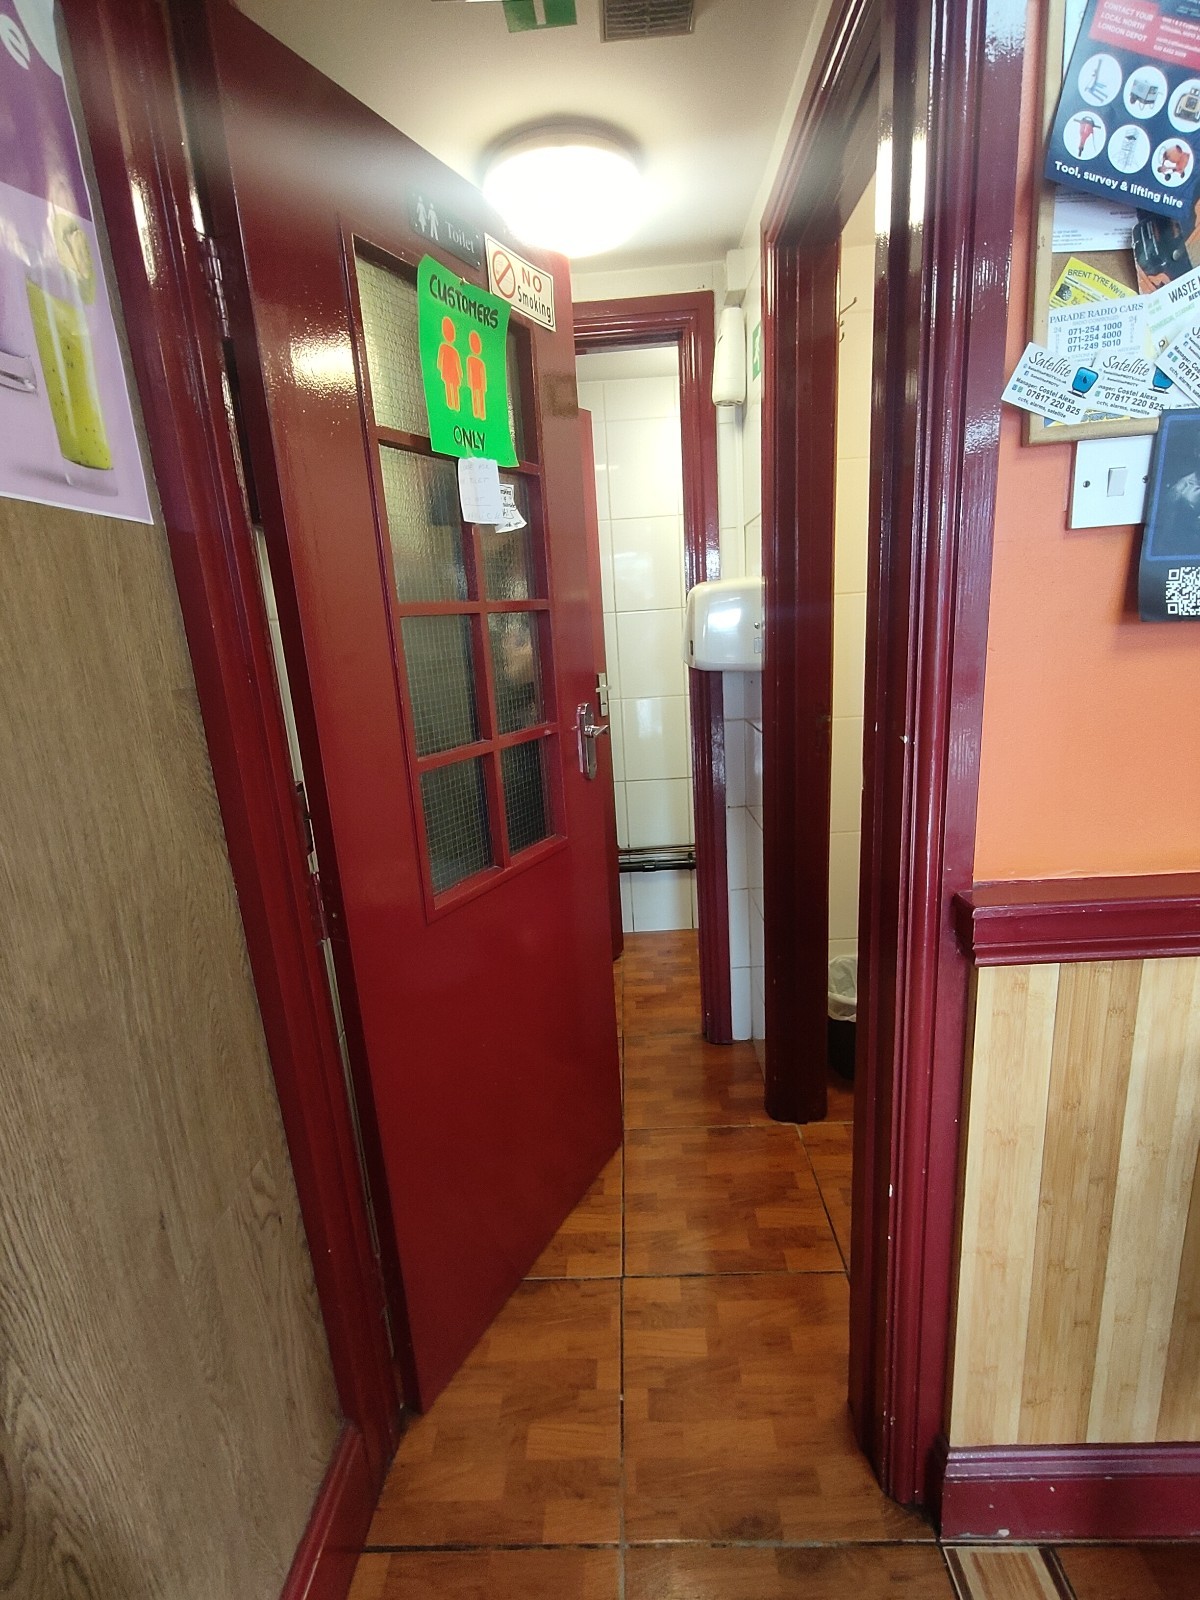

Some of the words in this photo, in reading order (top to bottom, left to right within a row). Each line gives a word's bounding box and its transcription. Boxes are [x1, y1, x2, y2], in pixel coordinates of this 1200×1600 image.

[1100, 11, 1122, 24] LOCAL
[1122, 18, 1146, 31] NORTH
[1103, 1, 1135, 16] CONTACT
[1135, 9, 1154, 21] YOUR
[1097, 22, 1125, 36] LONDON
[1125, 29, 1148, 42] DEPOT
[1055, 161, 1081, 179] Tool,
[1083, 171, 1119, 190] survey
[1119, 181, 1128, 191] &
[1130, 183, 1162, 203] lifting
[1162, 193, 1183, 209] hire
[445, 221, 475, 254] Toilet
[521, 266, 543, 293] NO
[1067, 268, 1092, 278] BRENT
[1093, 273, 1111, 287] TYRE
[429, 273, 499, 330] CUSTOMERS
[1168, 278, 1198, 304] WASTE
[517, 285, 552, 324] Smoking
[1049, 311, 1086, 324] PARADE
[1087, 306, 1118, 318] RADIO
[1119, 302, 1144, 313] CARS
[1067, 333, 1099, 345] 071-254
[1101, 330, 1122, 340] 4000
[1068, 325, 1100, 336] 071-254
[1103, 321, 1123, 331] 1000
[1067, 341, 1099, 353] 071-249
[1101, 338, 1121, 348] 5010
[1029, 351, 1072, 378] Satellite
[1102, 355, 1150, 377] Satellite
[1178, 361, 1200, 382] 07817
[1016, 377, 1038, 389] Manager:
[1038, 385, 1058, 398] Costel
[1057, 393, 1075, 405] Alexa
[1026, 388, 1050, 403] 07817
[1050, 398, 1065, 410] 220
[1065, 406, 1081, 416] 825
[1104, 391, 1131, 404] 07817
[1131, 397, 1148, 407] 220
[1148, 401, 1165, 412] 825
[1117, 386, 1139, 397] Costel
[1139, 391, 1158, 401] Alexa
[1047, 408, 1066, 418] satellite
[453, 425, 485, 452] ONLY
